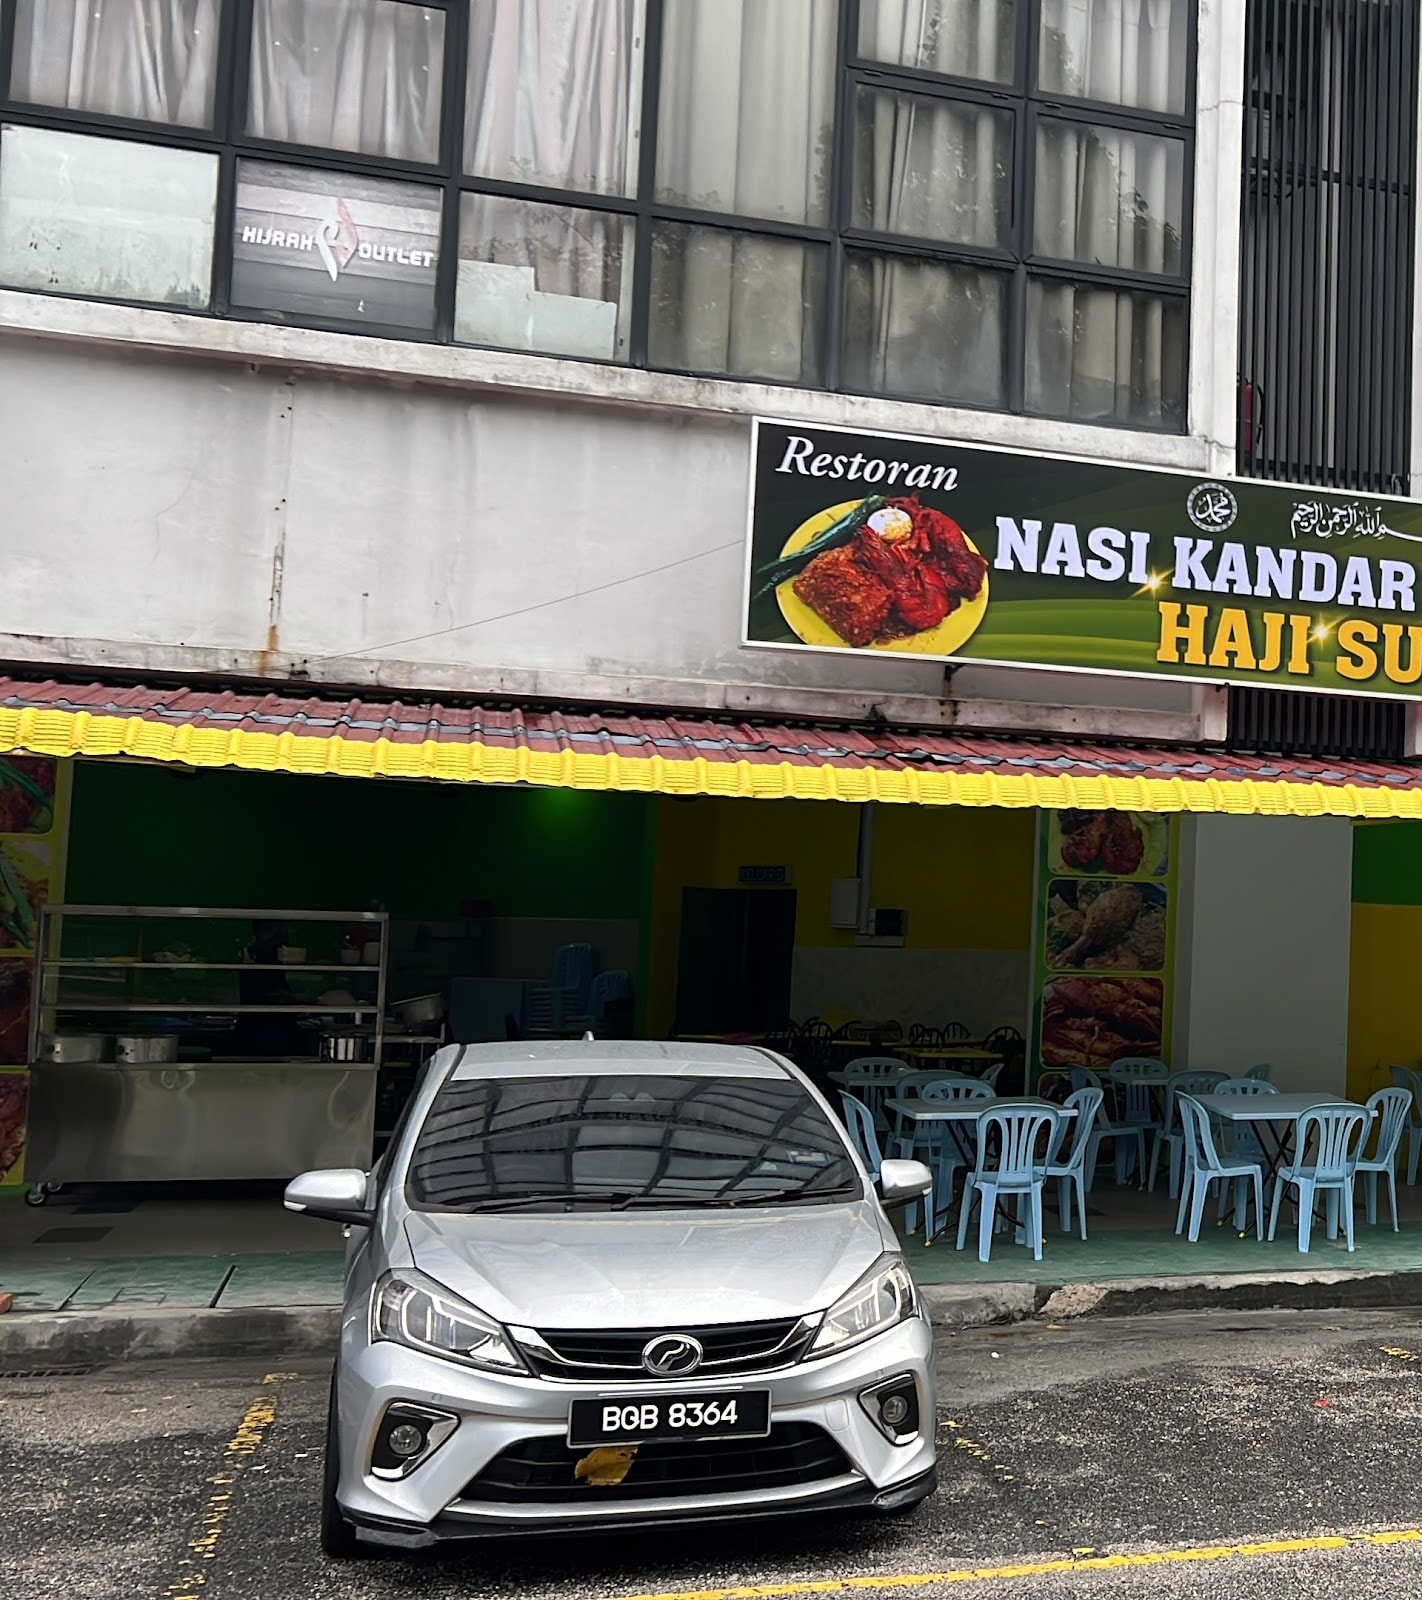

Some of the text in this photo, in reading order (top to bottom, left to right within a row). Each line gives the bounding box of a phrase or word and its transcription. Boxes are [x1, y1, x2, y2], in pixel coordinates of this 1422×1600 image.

[242, 226, 434, 267] HIJRAH OUTLET
[775, 435, 960, 492] Restoran
[993, 516, 1151, 585] NASI
[1171, 536, 1416, 612] KANDAR
[1157, 601, 1313, 674] HAJI
[668, 1400, 738, 1427] 8364
